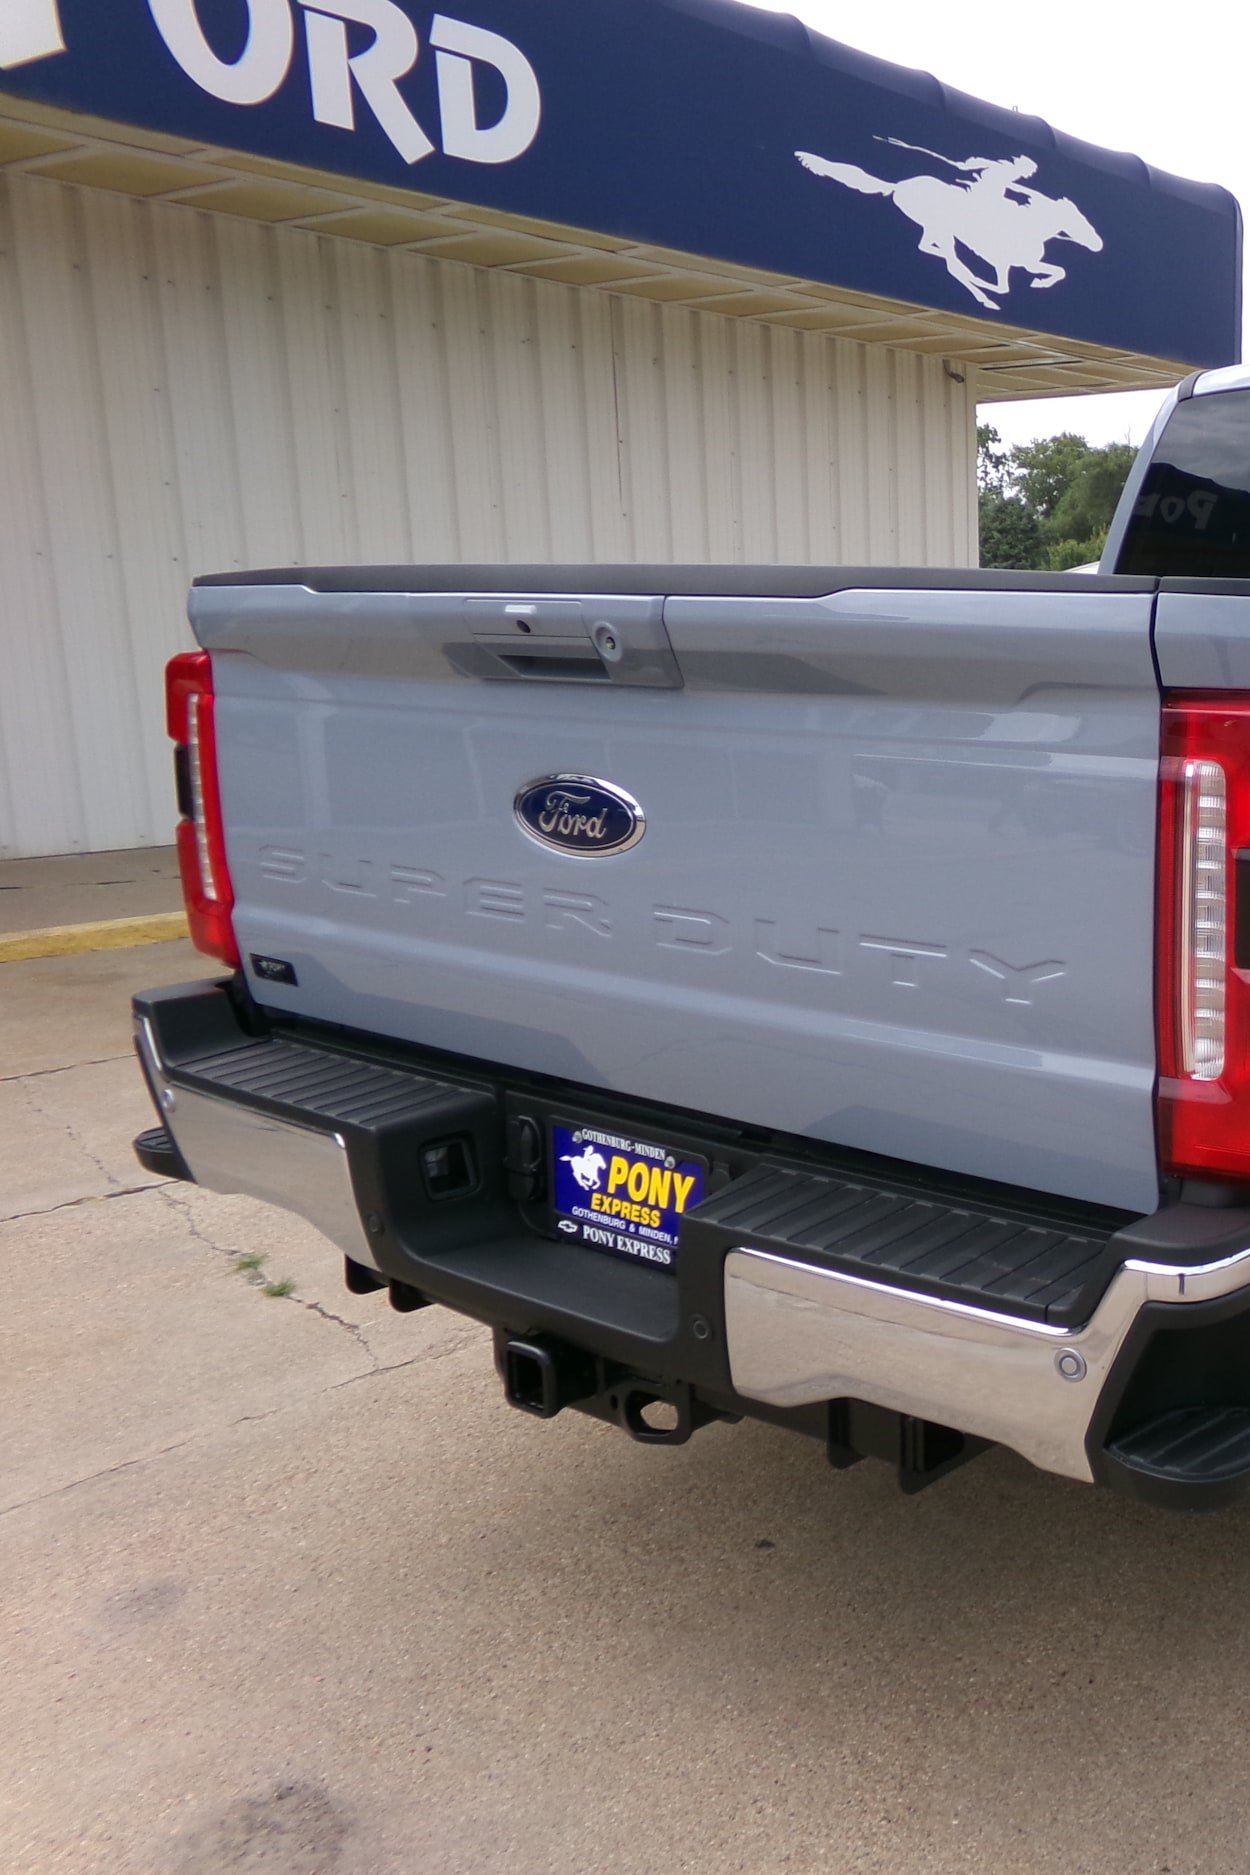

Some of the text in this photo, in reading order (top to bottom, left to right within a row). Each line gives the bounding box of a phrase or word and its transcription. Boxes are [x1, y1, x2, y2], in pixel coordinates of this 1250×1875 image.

[0, 0, 541, 165] ORD
[539, 790, 608, 839] Ford
[258, 844, 1067, 1005] SUPER DUTY
[607, 1155, 696, 1214] PONY
[571, 1206, 626, 1230] GOTHENBURG
[629, 1223, 635, 1233] &
[590, 1192, 661, 1228] EXPRESS
[582, 1225, 616, 1248] PONY
[616, 1235, 671, 1265] EXPRESS
